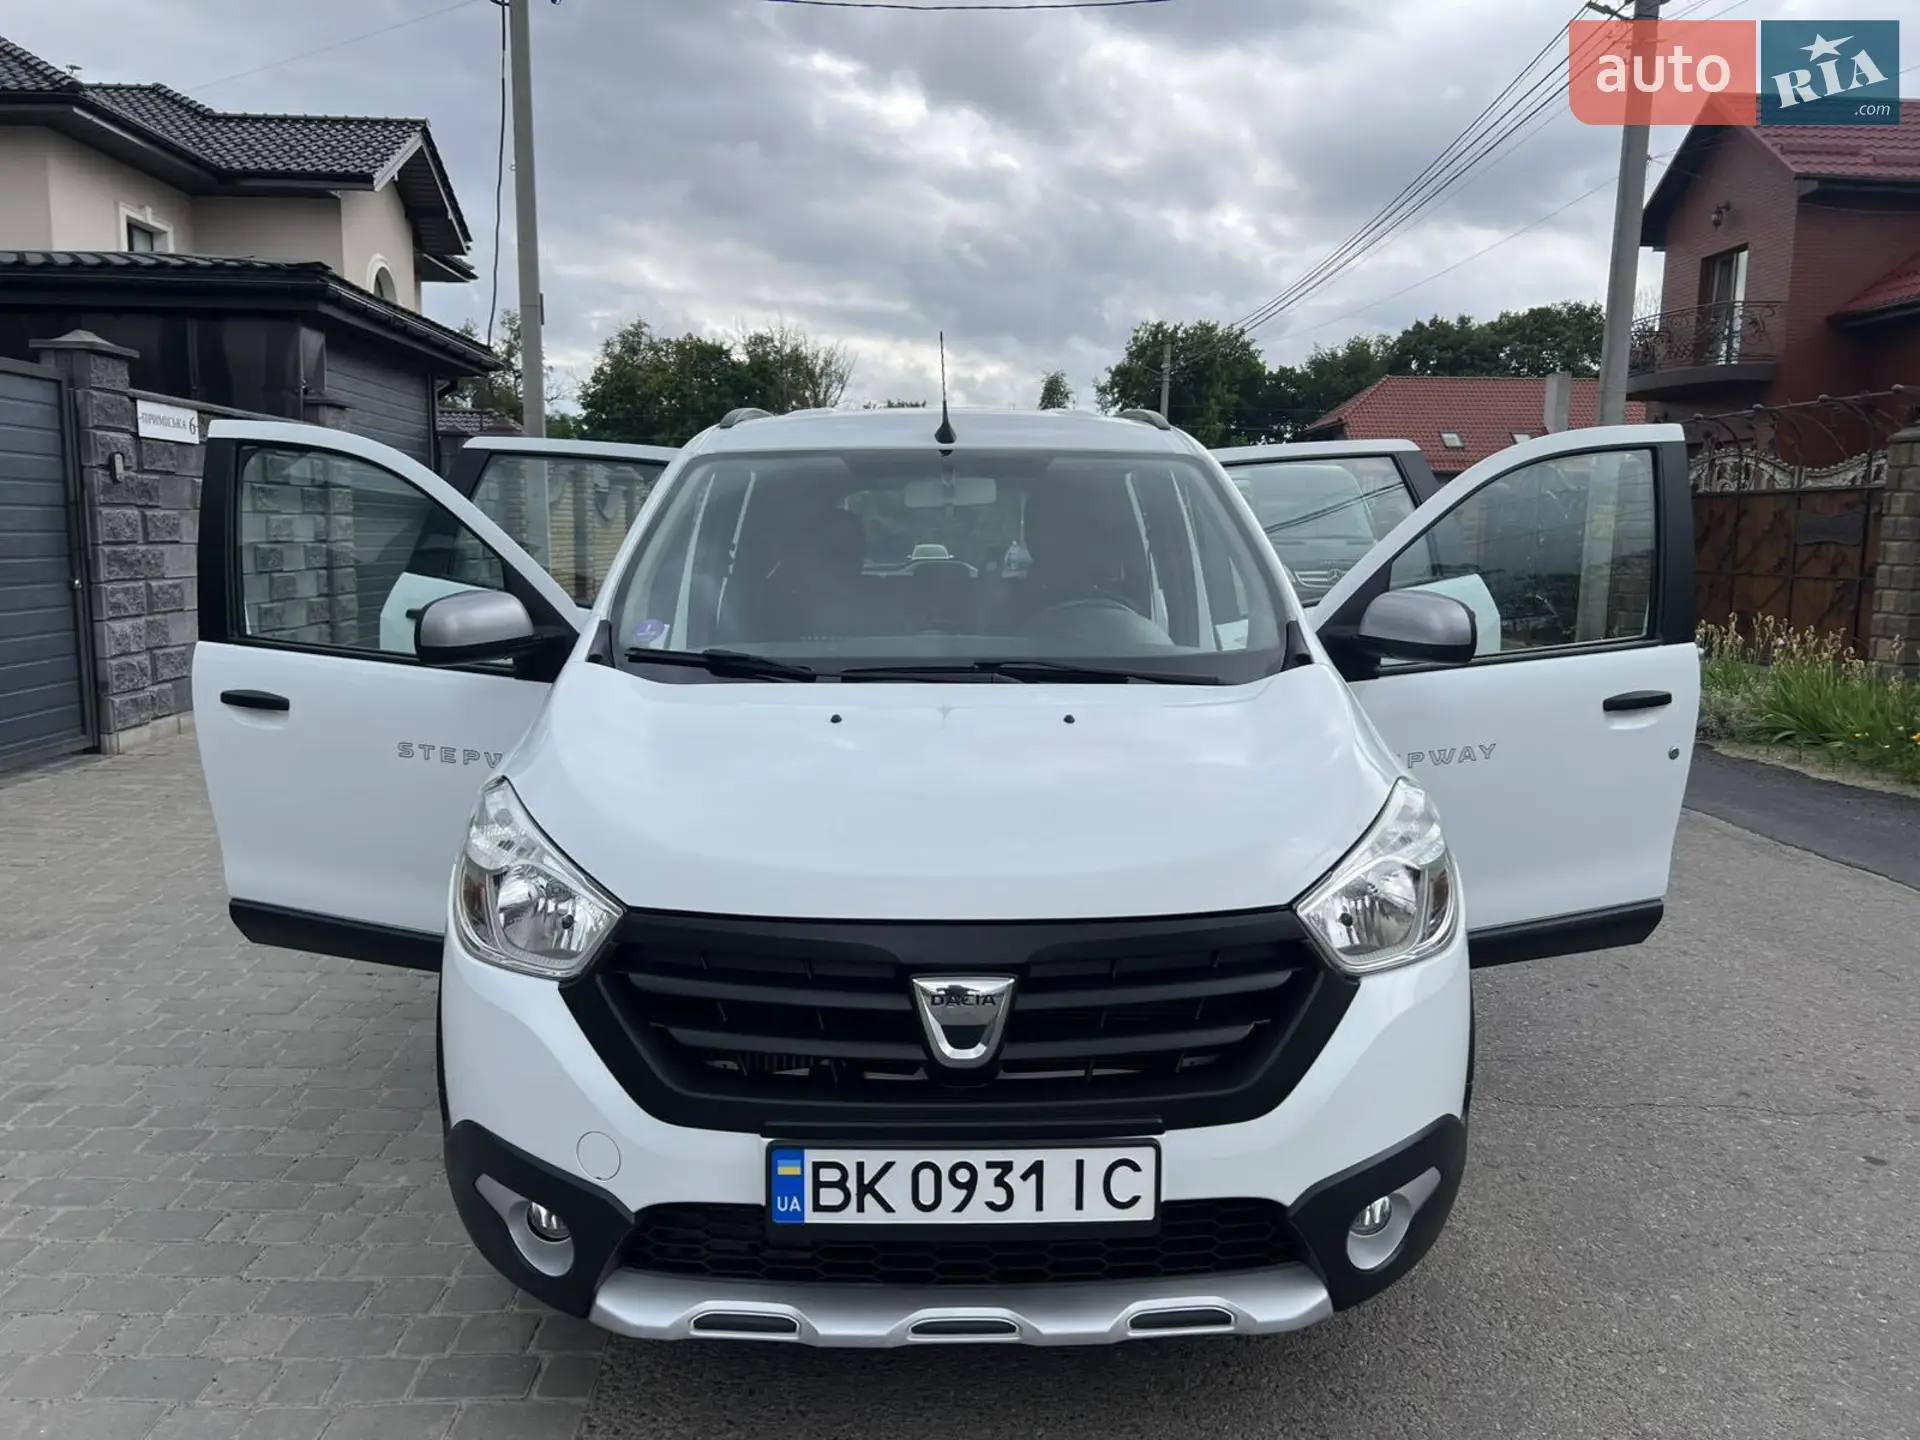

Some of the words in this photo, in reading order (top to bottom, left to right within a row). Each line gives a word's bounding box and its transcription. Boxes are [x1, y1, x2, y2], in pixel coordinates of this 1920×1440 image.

[189, 417, 196, 436] 6
[931, 994, 996, 1006] DACIA
[811, 1160, 896, 1213] BK
[911, 1160, 1044, 1213] 0931
[1075, 1158, 1142, 1211] IC
[777, 1195, 801, 1212] UA
